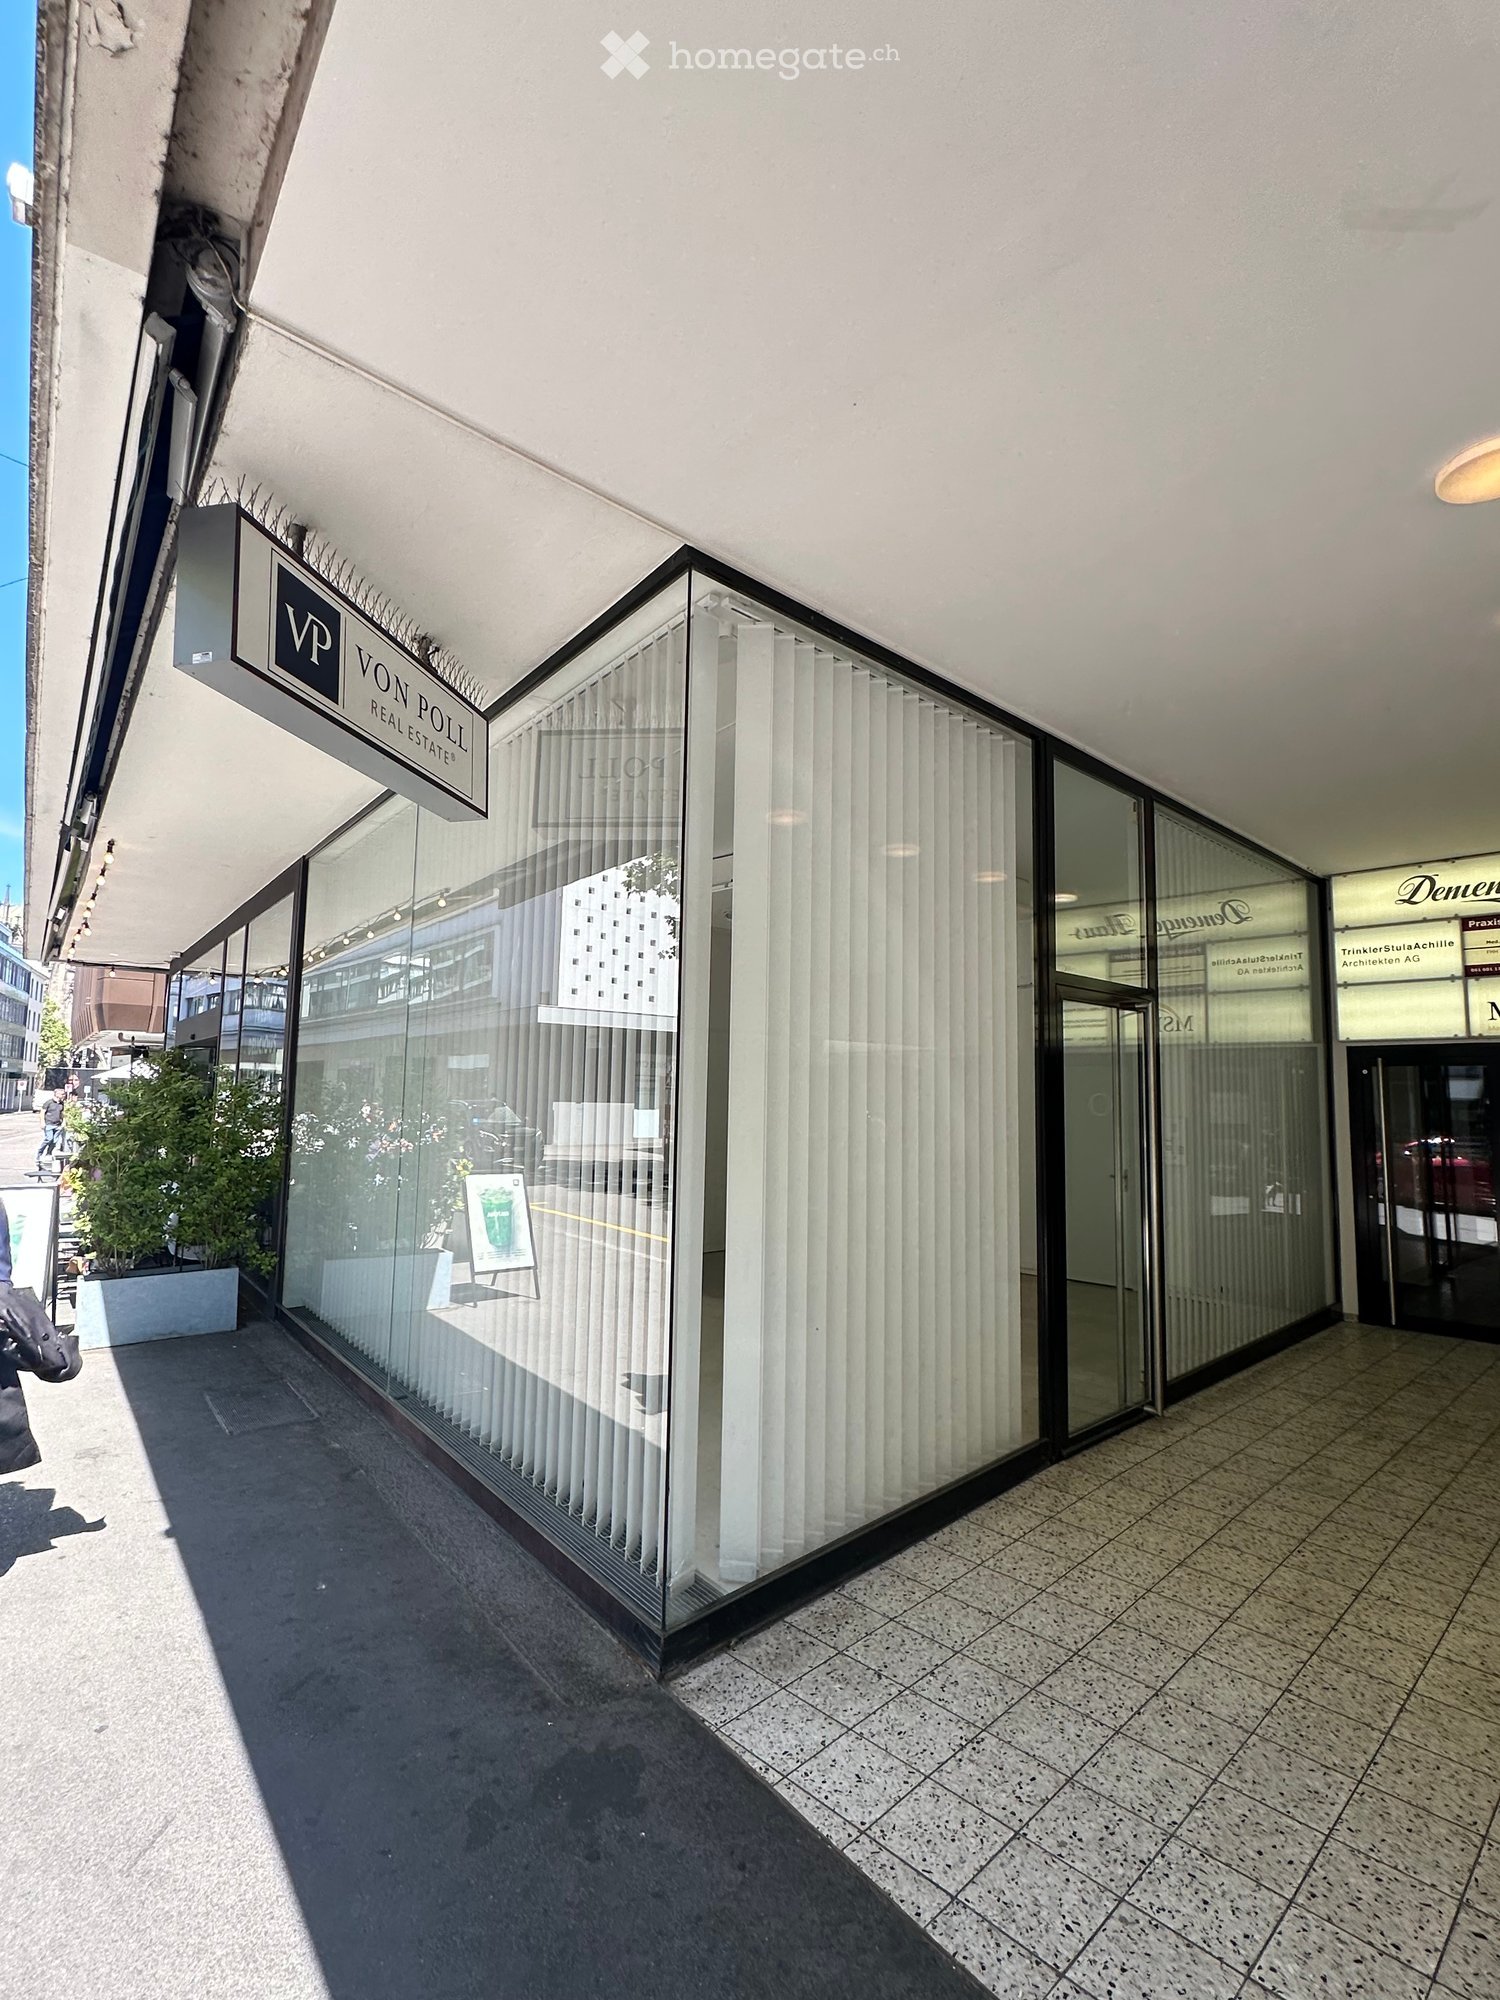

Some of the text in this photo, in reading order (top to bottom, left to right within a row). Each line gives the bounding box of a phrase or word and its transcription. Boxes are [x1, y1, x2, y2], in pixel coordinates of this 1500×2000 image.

[285, 602, 332, 666] VP
[355, 644, 468, 753] VON POLL
[370, 699, 404, 735] REAL
[1341, 940, 1455, 956] TrinklerStulaAchille
[1342, 954, 1421, 968] Architekten AG
